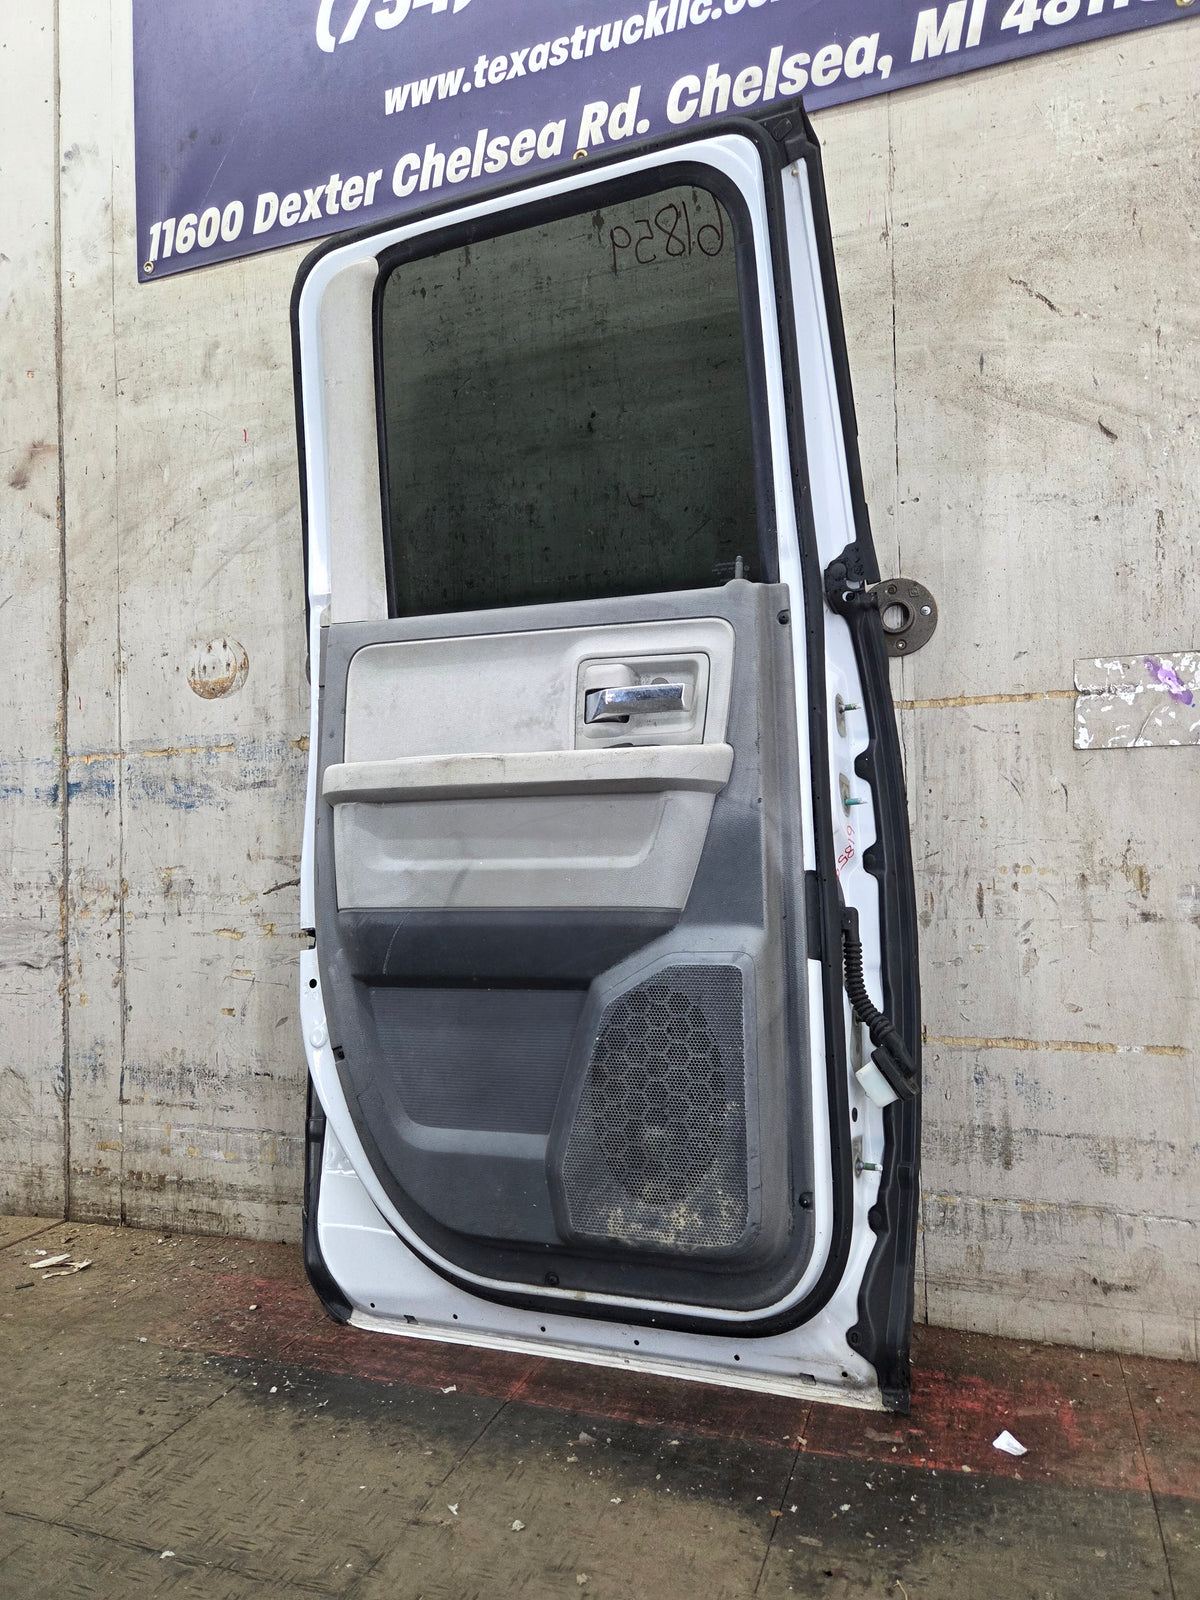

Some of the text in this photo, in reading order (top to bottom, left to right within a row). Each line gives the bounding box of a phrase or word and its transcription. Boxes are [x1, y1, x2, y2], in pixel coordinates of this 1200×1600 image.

[148, 200, 244, 261] 11600
[253, 168, 384, 235] Dexter
[392, 117, 567, 198] Chelsea
[576, 84, 650, 150] Rd.
[666, 32, 893, 125] Chelsea,
[911, 0, 988, 63] MI
[385, 0, 781, 116] www.texastruckllc.c
